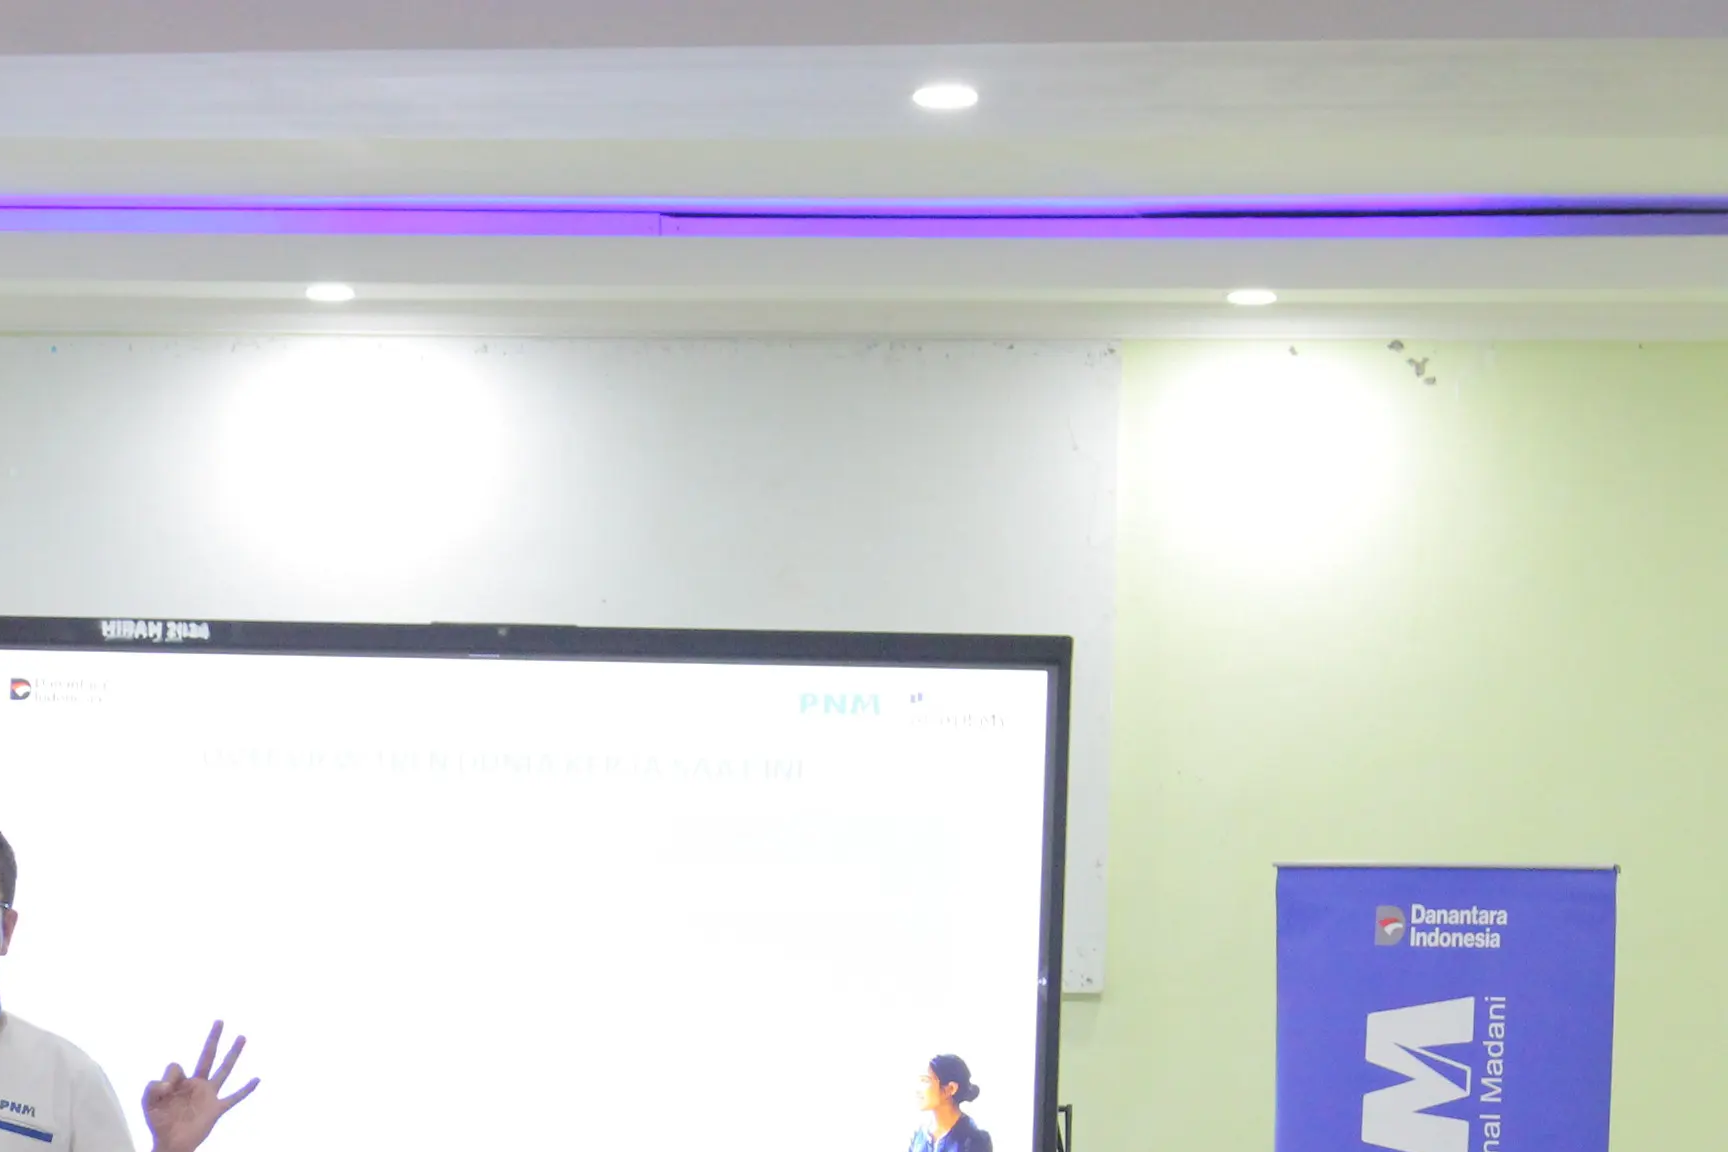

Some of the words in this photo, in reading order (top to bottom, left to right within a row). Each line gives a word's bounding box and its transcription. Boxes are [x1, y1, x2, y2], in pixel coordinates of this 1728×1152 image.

[799, 693, 881, 715] PNM
[1410, 903, 1508, 926] Danantara
[1410, 926, 1501, 948] Indonesia
[1480, 996, 1506, 1103] Madani
[0, 1099, 36, 1118] PNM
